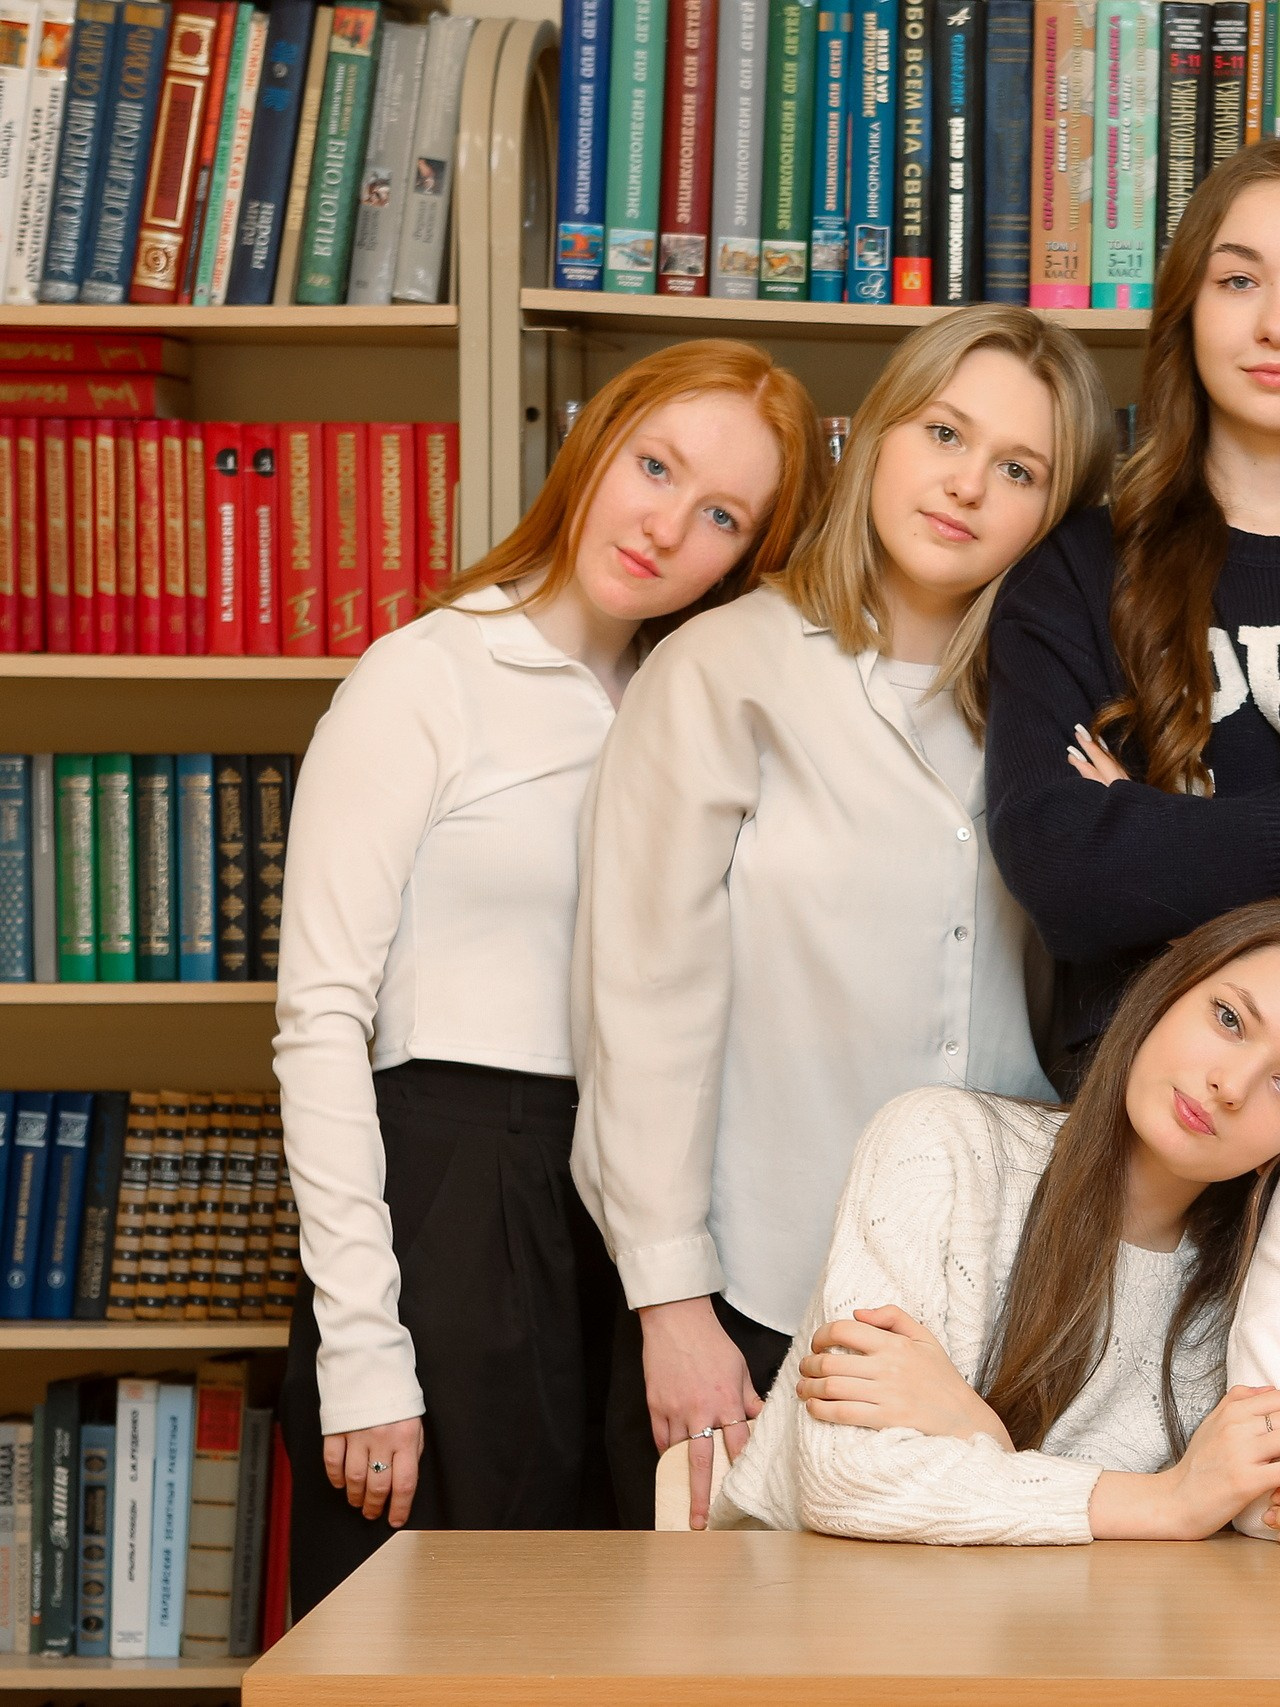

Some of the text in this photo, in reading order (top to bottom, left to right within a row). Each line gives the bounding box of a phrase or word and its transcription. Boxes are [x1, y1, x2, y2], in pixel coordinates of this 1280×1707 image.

[680, 56, 699, 88] ДЛЯ
[826, 83, 841, 108] ДЛЯ
[827, 40, 843, 79] ДЕТЕЙ
[860, 12, 879, 119] ЭНЦИКЛОПЕДИЯ
[875, 28, 891, 72] ДЕТЕЙ
[574, 46, 597, 216] ЭНЦИКЛОПЕДИЯ ДЛЯ
[624, 50, 650, 220] ЭНЦИКЛОПЕДИЯ ДЛЯ
[674, 94, 698, 225] ЭНЦИКЛОПЕДИЯ
[732, 1, 757, 227] ЭНЦИКЛОПЕДИЯ ДЛЯ ДЕТЕЙ
[774, 6, 801, 231] ЭНЦИКЛОПЕДИЯ ДЛЯ ДЕТЕЙ
[822, 112, 840, 212] ЭНЦИКЛОПЕДИЯ
[902, 0, 923, 237] БО ВСЕМ НА СВЕТЕ
[948, 117, 967, 159] ДЕТЕЙ
[1042, 17, 1058, 231] СПРАВОЧНИК ШКОЛЬНИКА
[1106, 16, 1121, 230] СПРАВОЧНИК ШКОЛЬНИКА
[1169, 80, 1199, 157] ШКОЛЬНИКА
[312, 140, 347, 257] БИОЛОГИЯ
[865, 121, 882, 219] ИНФОРМАТИКА
[948, 162, 965, 191] ДЛЯ
[948, 194, 965, 301] ЭНЦИКЛОПЕДИЯ
[1043, 267, 1079, 281] КЛАСС
[1044, 240, 1067, 253] ТОМ
[1106, 267, 1143, 280] КЛАСС
[1107, 240, 1131, 253] ТОМ
